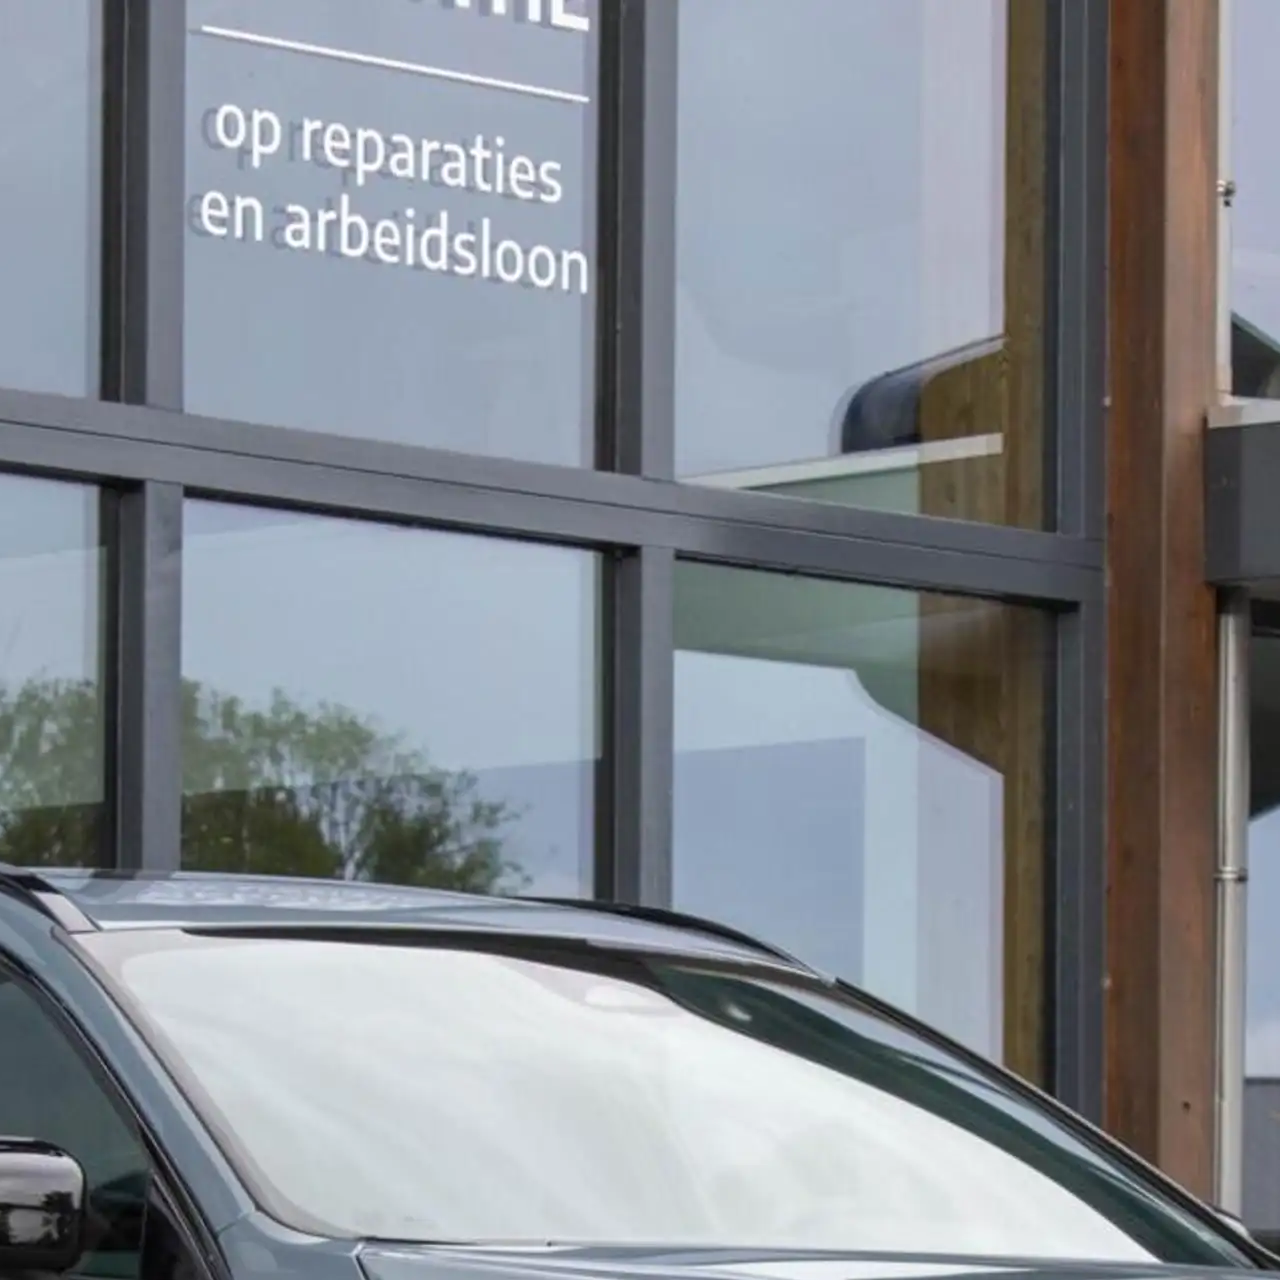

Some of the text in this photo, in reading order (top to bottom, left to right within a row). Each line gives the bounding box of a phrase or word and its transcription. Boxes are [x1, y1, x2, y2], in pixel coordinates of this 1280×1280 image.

[216, 103, 562, 203] op reparaties
[201, 189, 588, 294] en arbeidsloon
